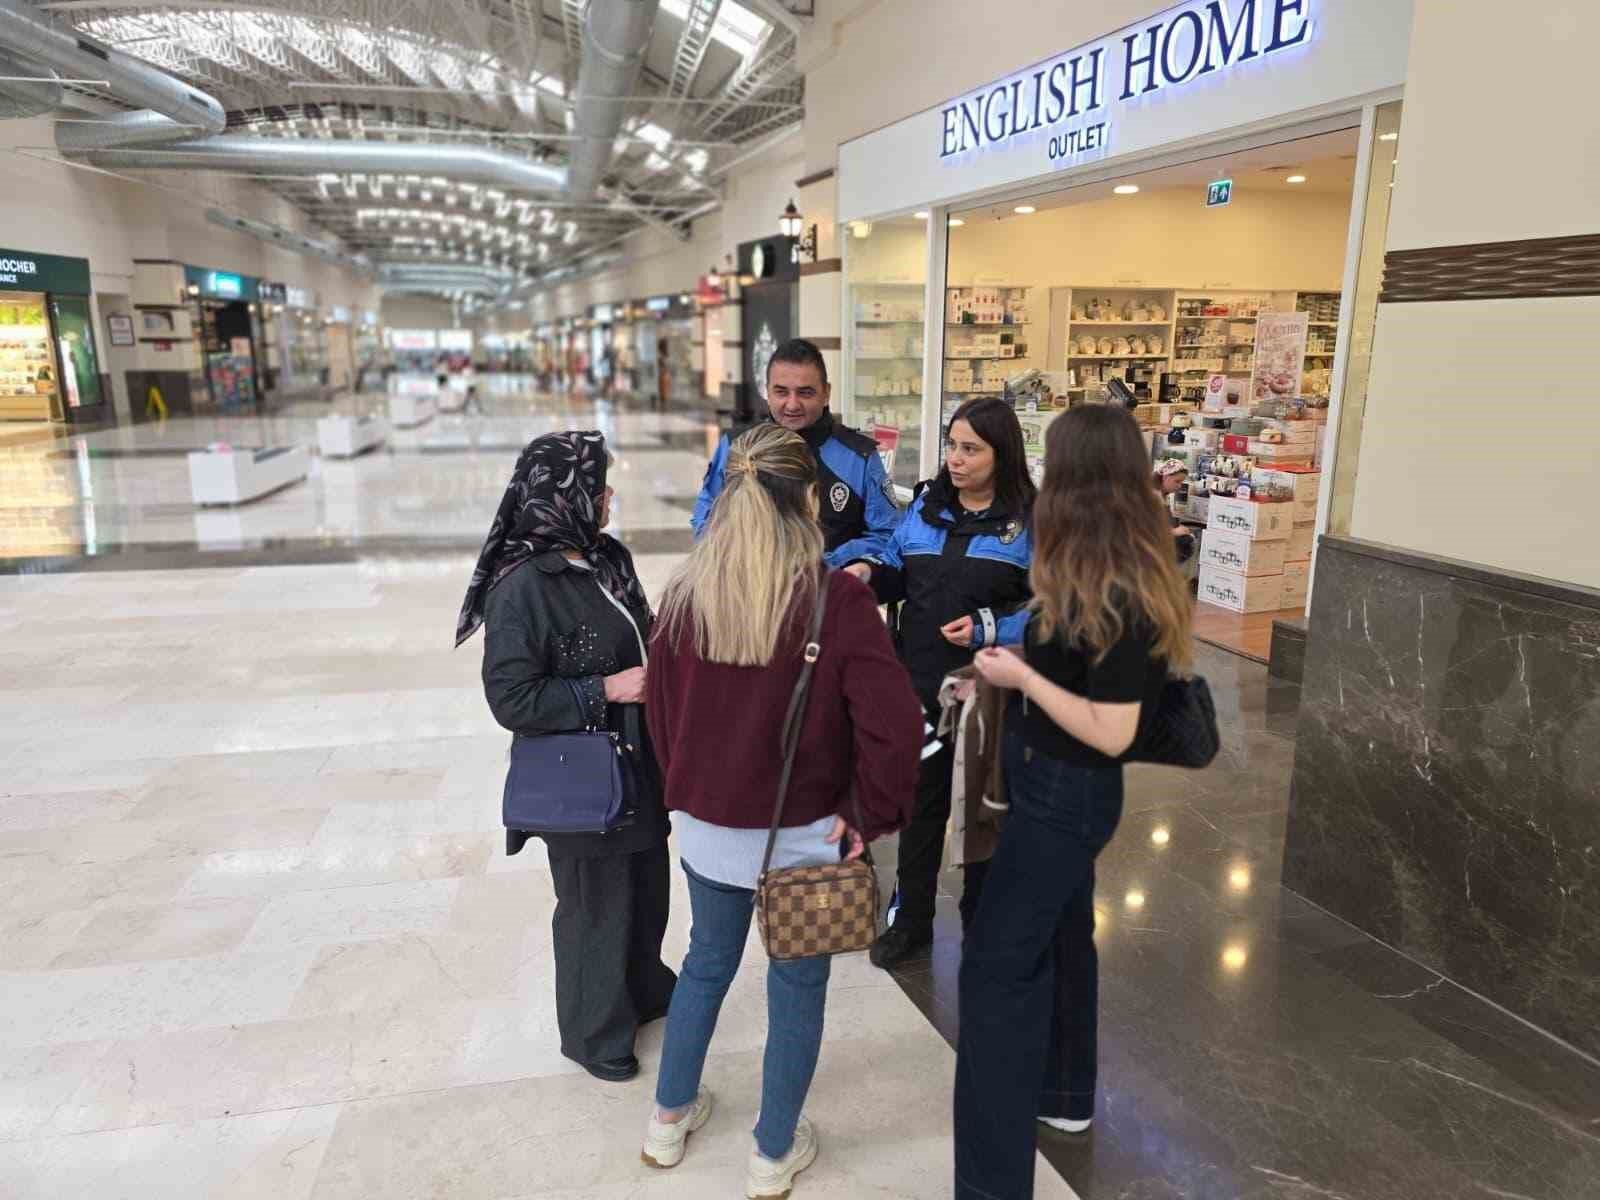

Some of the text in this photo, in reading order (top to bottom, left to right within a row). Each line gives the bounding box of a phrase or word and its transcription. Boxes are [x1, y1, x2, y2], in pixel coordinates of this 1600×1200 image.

[940, 0, 1309, 158] ENGLISH HOME
[1047, 121, 1106, 160] OUTLET
